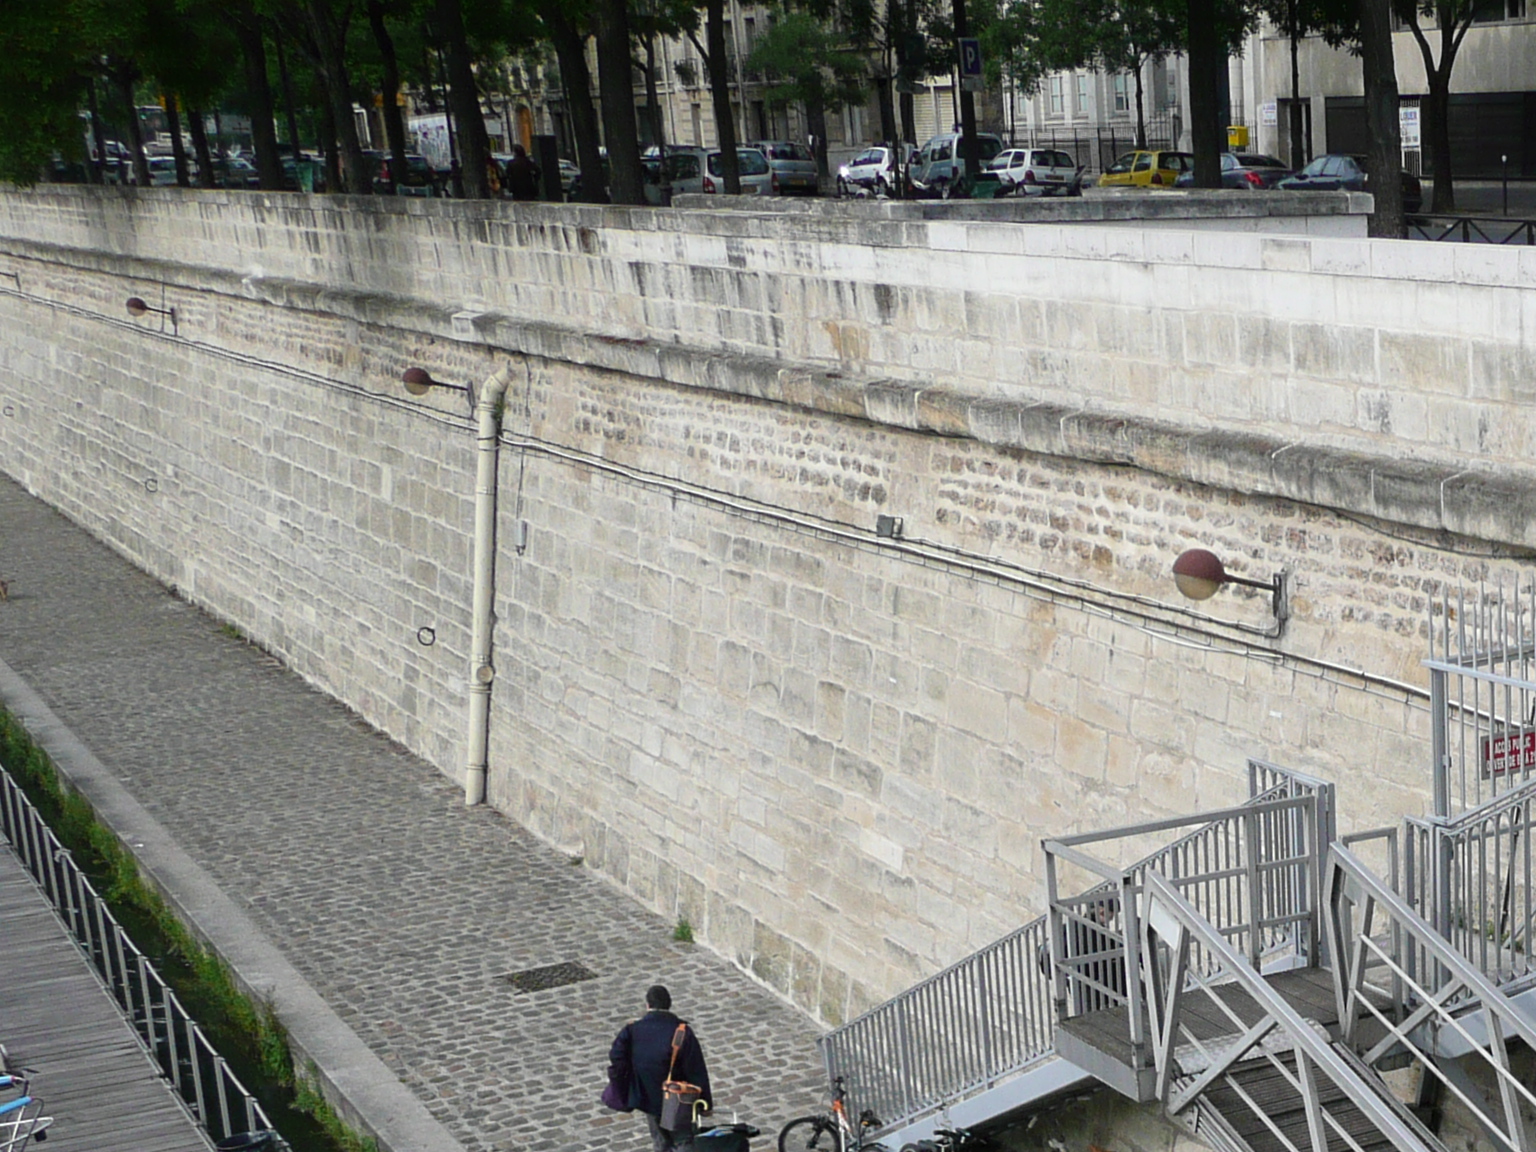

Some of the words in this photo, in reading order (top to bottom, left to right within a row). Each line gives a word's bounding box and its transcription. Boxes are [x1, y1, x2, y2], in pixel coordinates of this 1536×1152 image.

[966, 46, 975, 69] P
[1494, 739, 1511, 754] ACCS
[1512, 736, 1531, 751] PUIC
[1486, 757, 1506, 772] OVER
